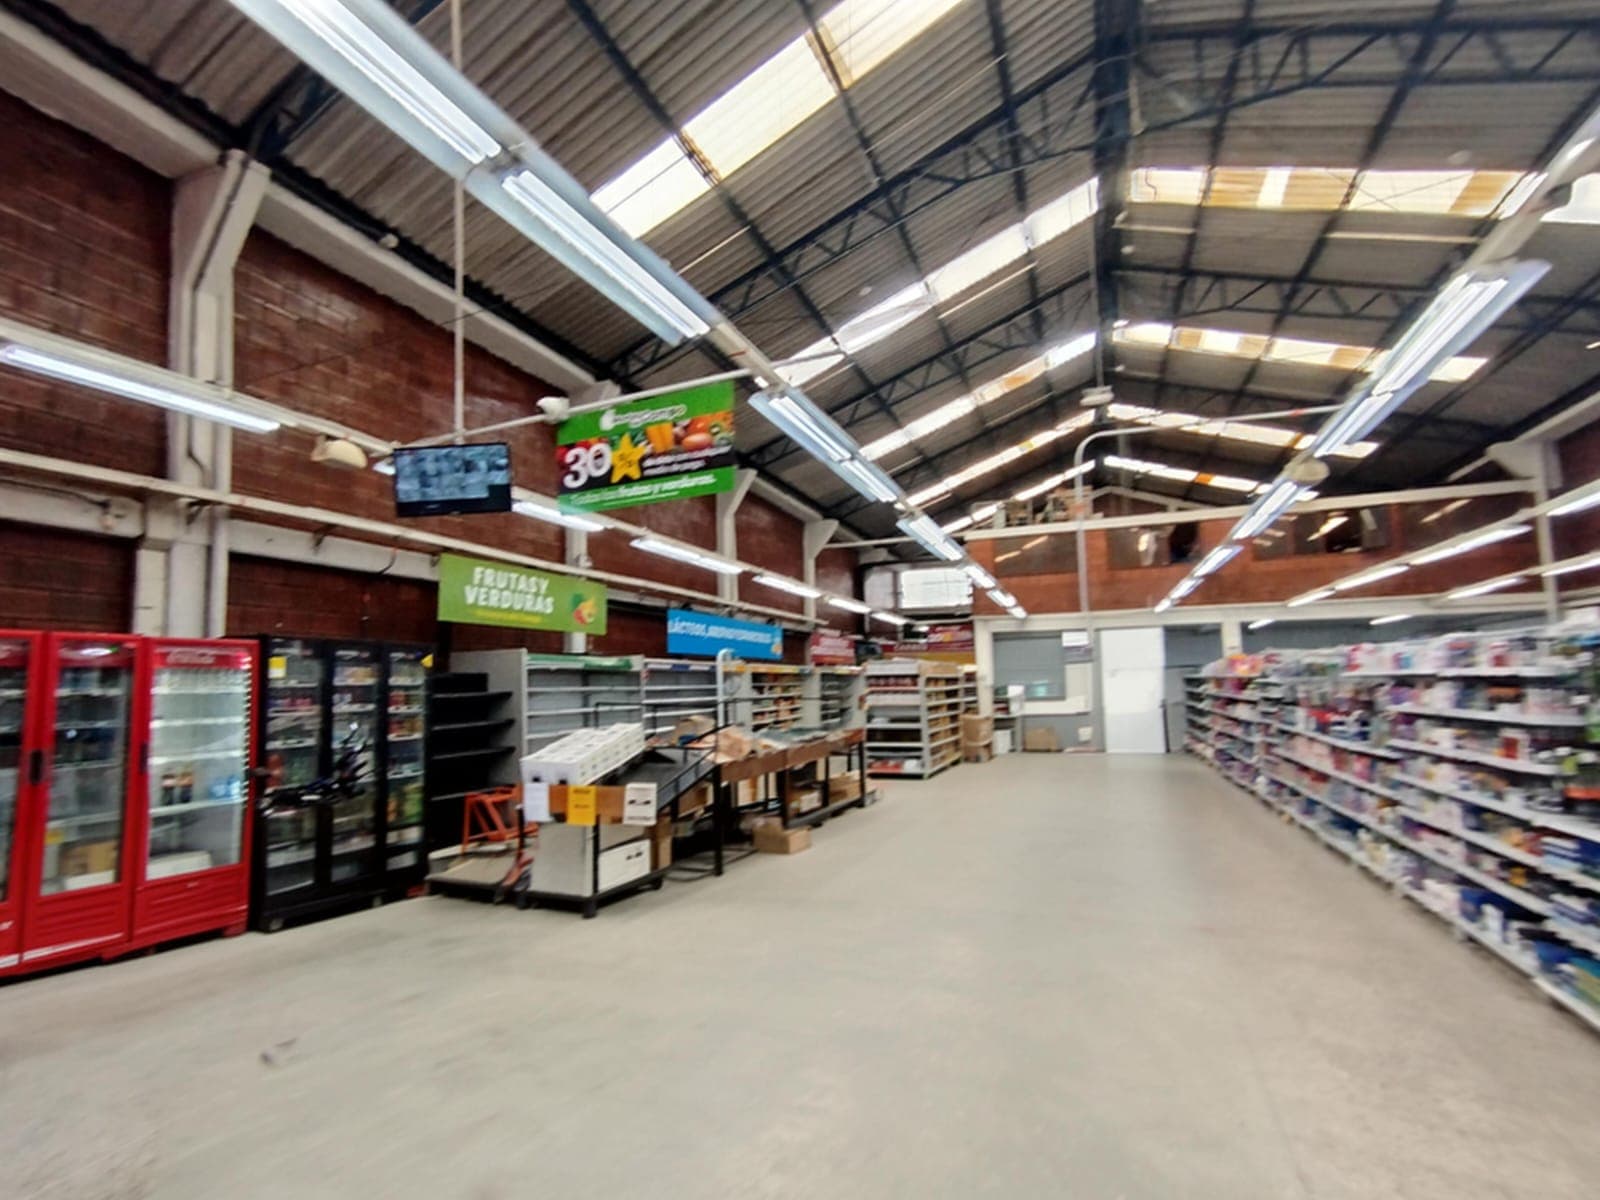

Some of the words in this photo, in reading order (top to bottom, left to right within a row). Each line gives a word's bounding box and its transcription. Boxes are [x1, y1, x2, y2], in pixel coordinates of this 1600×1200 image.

[563, 443, 612, 489] 30
[472, 567, 539, 593] FRUTAS
[464, 585, 555, 614] VERDURAS
